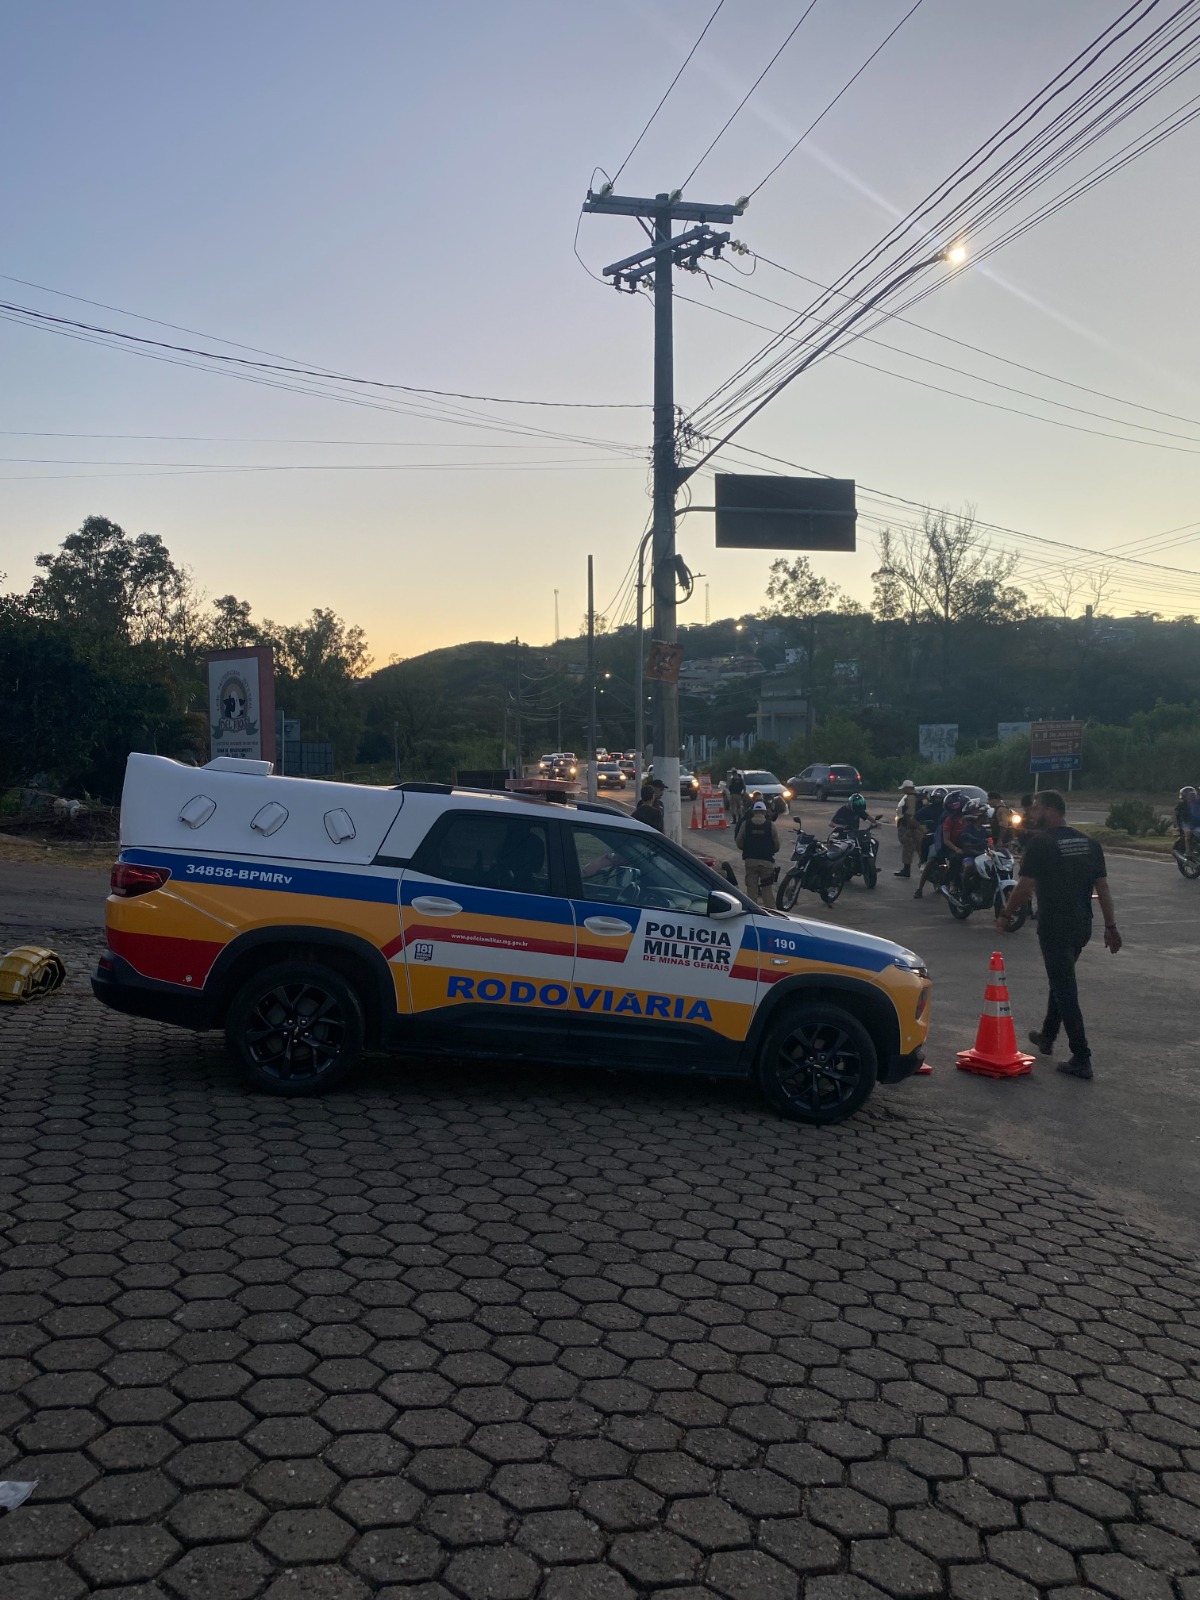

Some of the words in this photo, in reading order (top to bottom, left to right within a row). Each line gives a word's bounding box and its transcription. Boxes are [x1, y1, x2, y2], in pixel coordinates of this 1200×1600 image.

[186, 864, 292, 884] 34858-BPMRv
[416, 944, 432, 954] 181
[643, 939, 731, 965] MILITAR
[774, 938, 796, 951] 190
[643, 954, 656, 962] DE
[658, 956, 690, 967] MINAS
[693, 961, 730, 972] GERAIS
[447, 976, 713, 1022] RODOVIÁRIA
